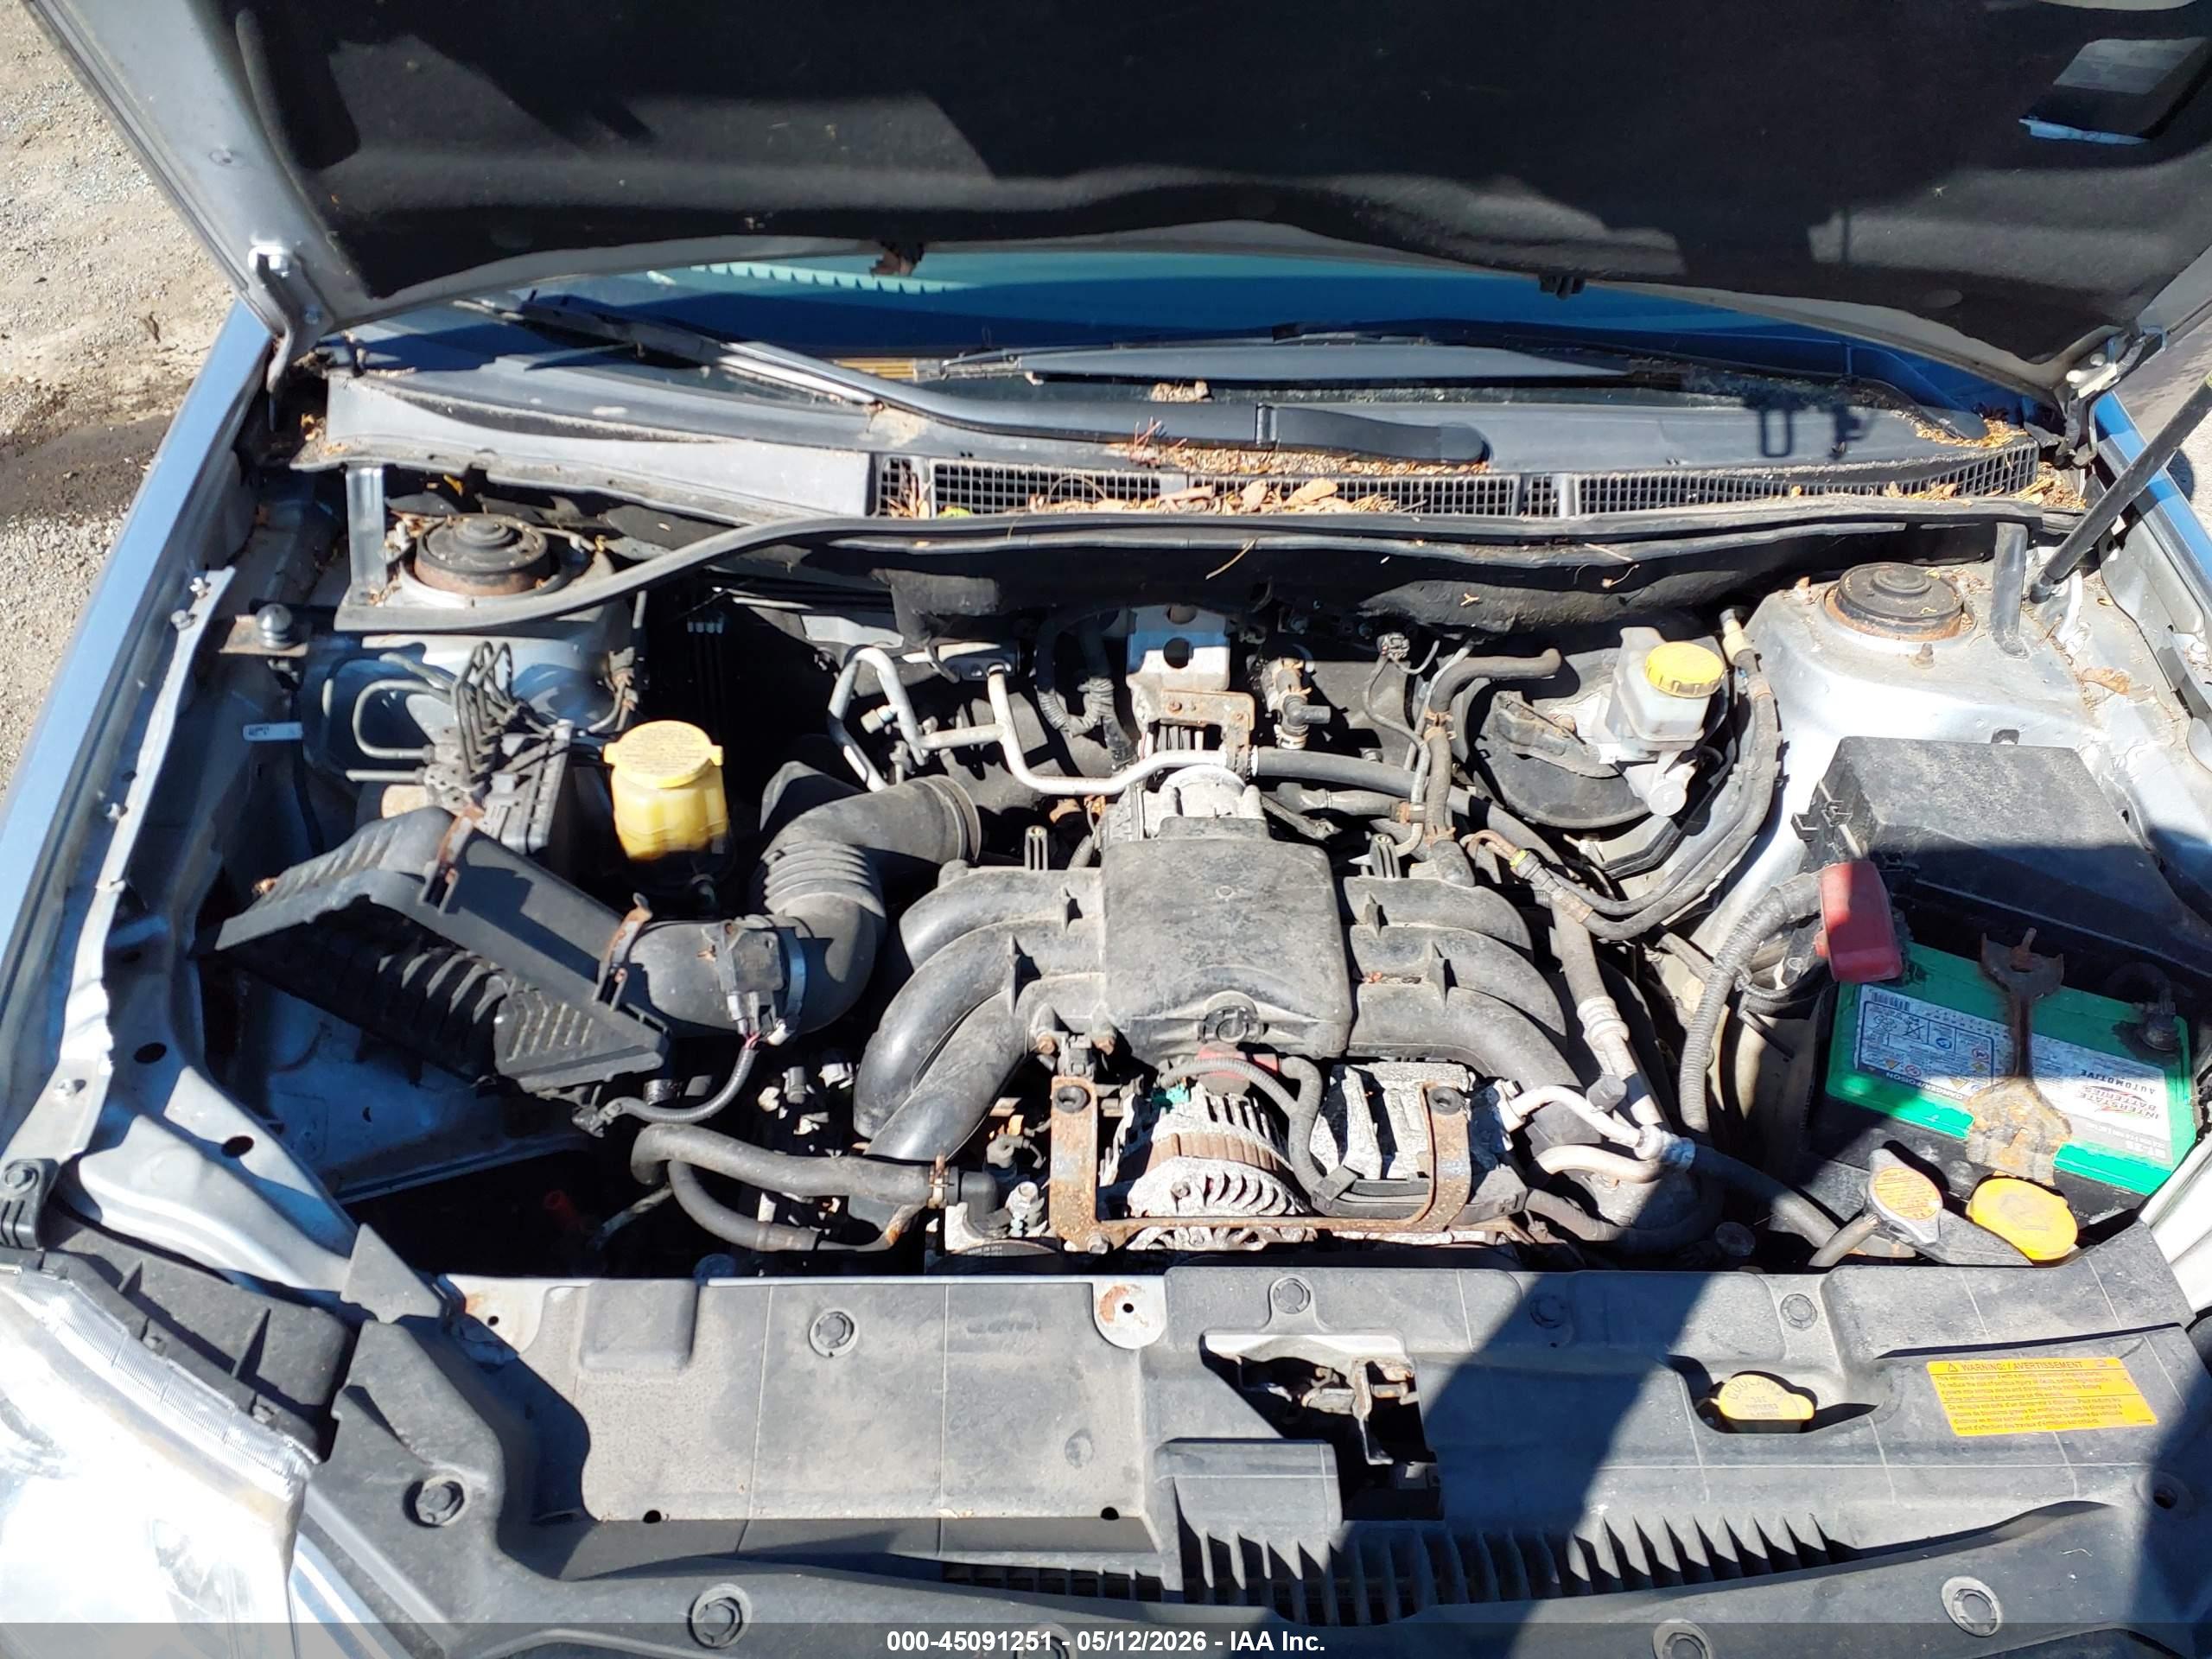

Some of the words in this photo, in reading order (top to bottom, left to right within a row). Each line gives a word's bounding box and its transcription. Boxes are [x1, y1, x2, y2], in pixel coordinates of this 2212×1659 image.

[1886, 1072, 1964, 1101] DANGER/POISON
[2081, 1070, 2156, 1094] AUTOMOTIVE
[2081, 1093, 2159, 1120] INTERSTATE
[2084, 1086, 2156, 1111] BATTERIES
[2013, 1361, 2083, 1370] AVERTISSEMENT
